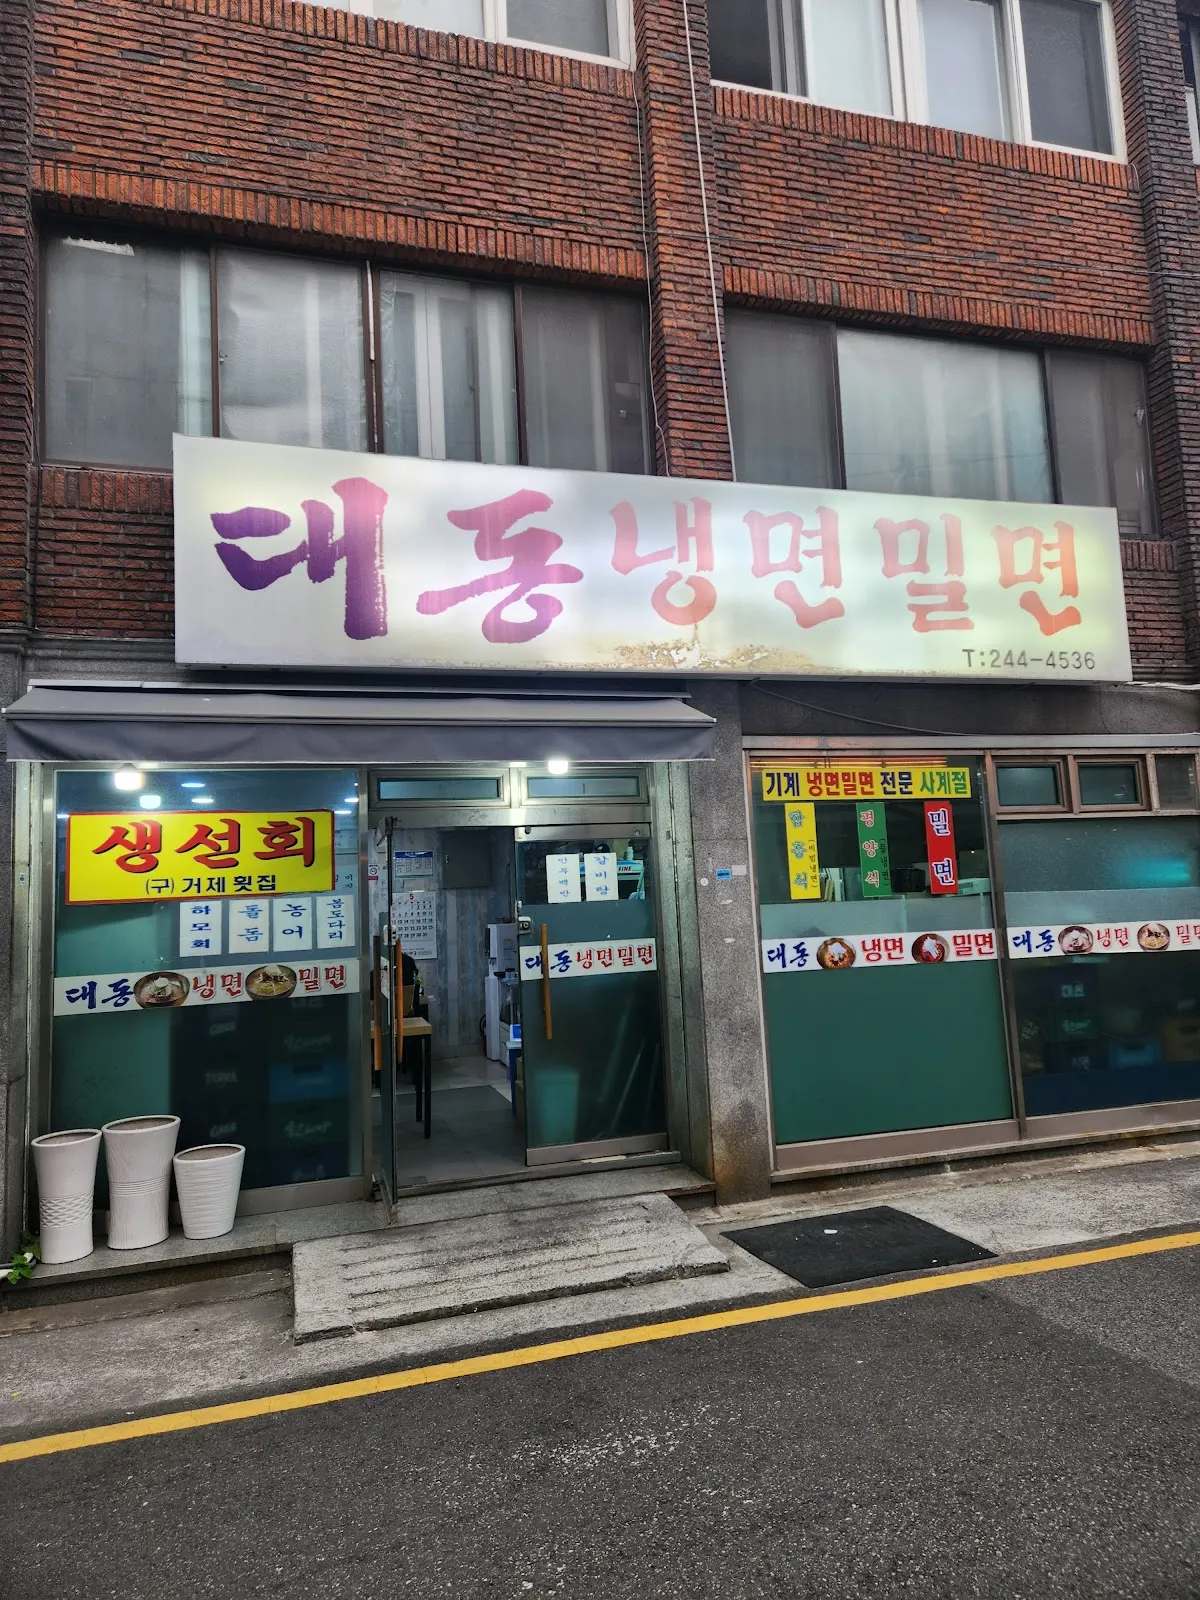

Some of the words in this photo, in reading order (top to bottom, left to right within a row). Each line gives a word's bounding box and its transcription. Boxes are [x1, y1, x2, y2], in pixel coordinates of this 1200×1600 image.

[962, 648, 1095, 669] T:244-4536
[765, 771, 800, 797] 기계
[880, 770, 913, 795] 전문
[919, 770, 967, 795] 사계절
[91, 816, 316, 874] 생선회
[860, 809, 880, 889] 평양식
[927, 808, 955, 886] 밀면
[145, 878, 175, 894] (구)
[189, 905, 212, 949] 하모회
[236, 904, 263, 942] 돌돔
[281, 903, 306, 940] 농어
[325, 898, 346, 940] 봄도다리
[767, 941, 810, 969] 대동
[861, 937, 905, 962] 냉면
[952, 932, 995, 957] 밀면
[1012, 929, 1056, 953] 대동
[1096, 927, 1130, 948] 냉면
[65, 978, 133, 1010] 대동
[191, 971, 243, 999] 냉면
[298, 964, 345, 992] 밀면
